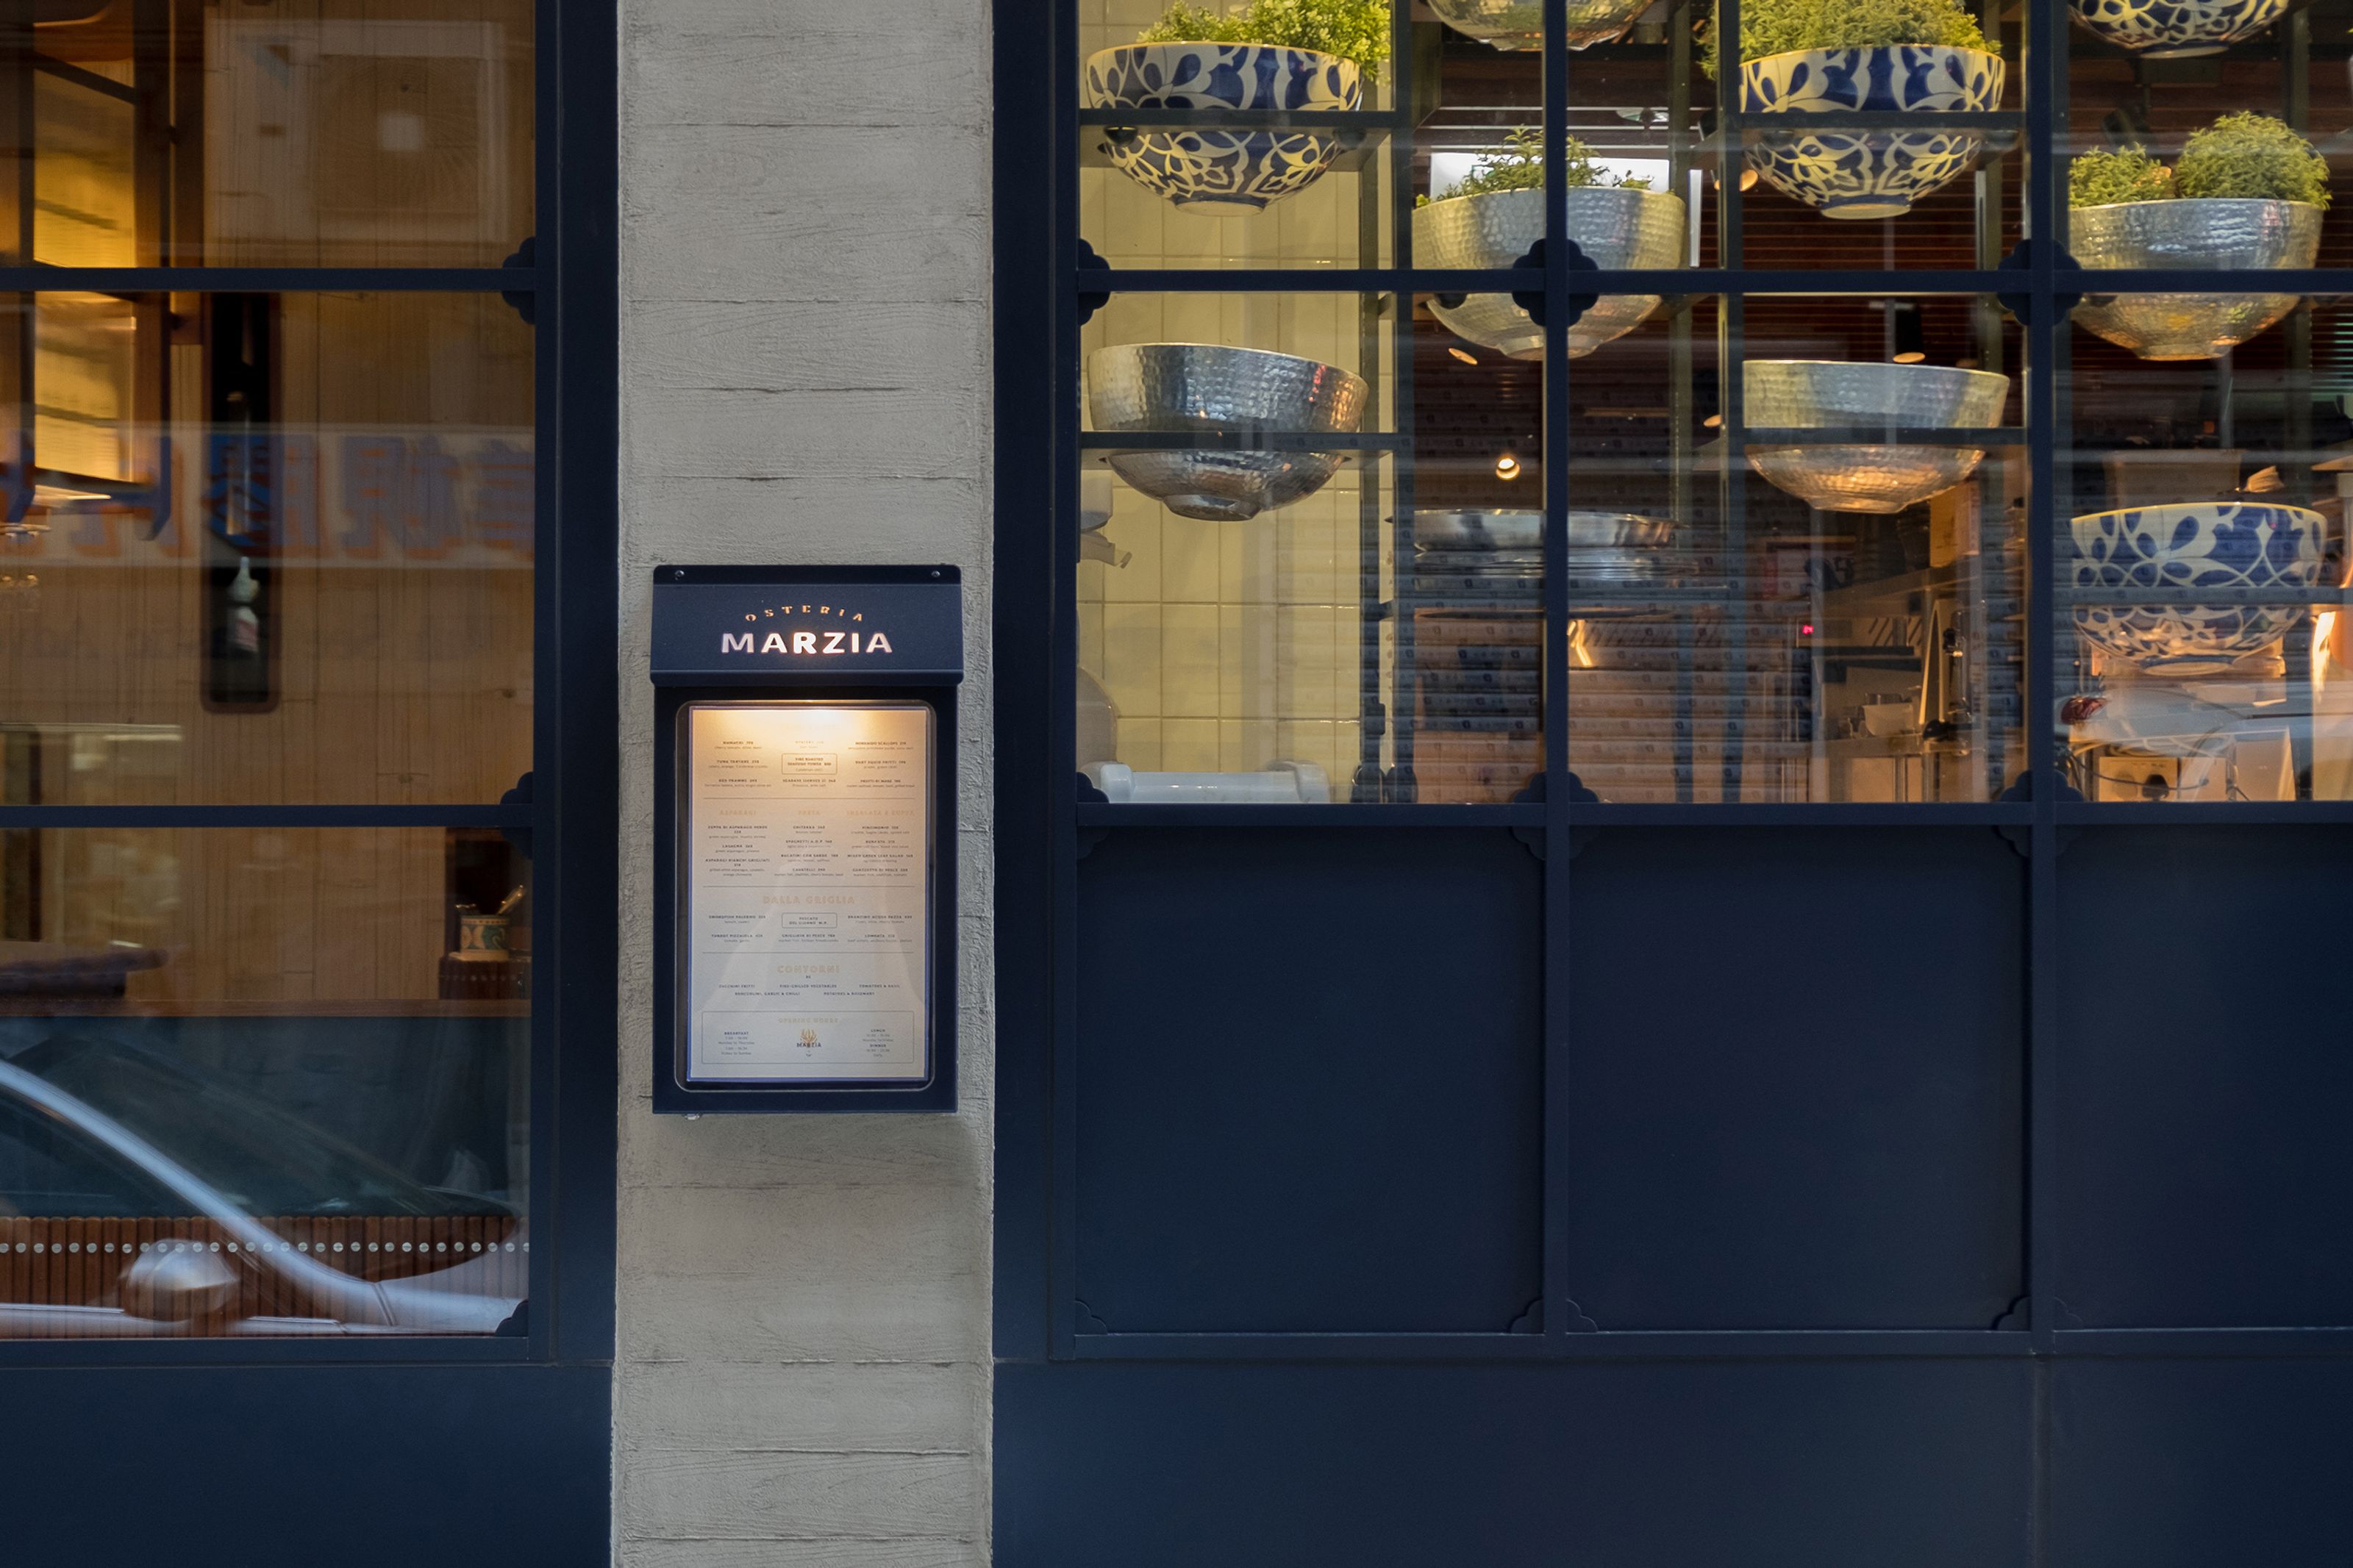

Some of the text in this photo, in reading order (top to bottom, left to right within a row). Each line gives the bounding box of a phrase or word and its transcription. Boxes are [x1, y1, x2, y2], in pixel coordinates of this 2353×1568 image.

[745, 604, 863, 622] OSTERIA
[721, 631, 893, 654] MARZIA
[805, 895, 854, 904] GRIGLIA
